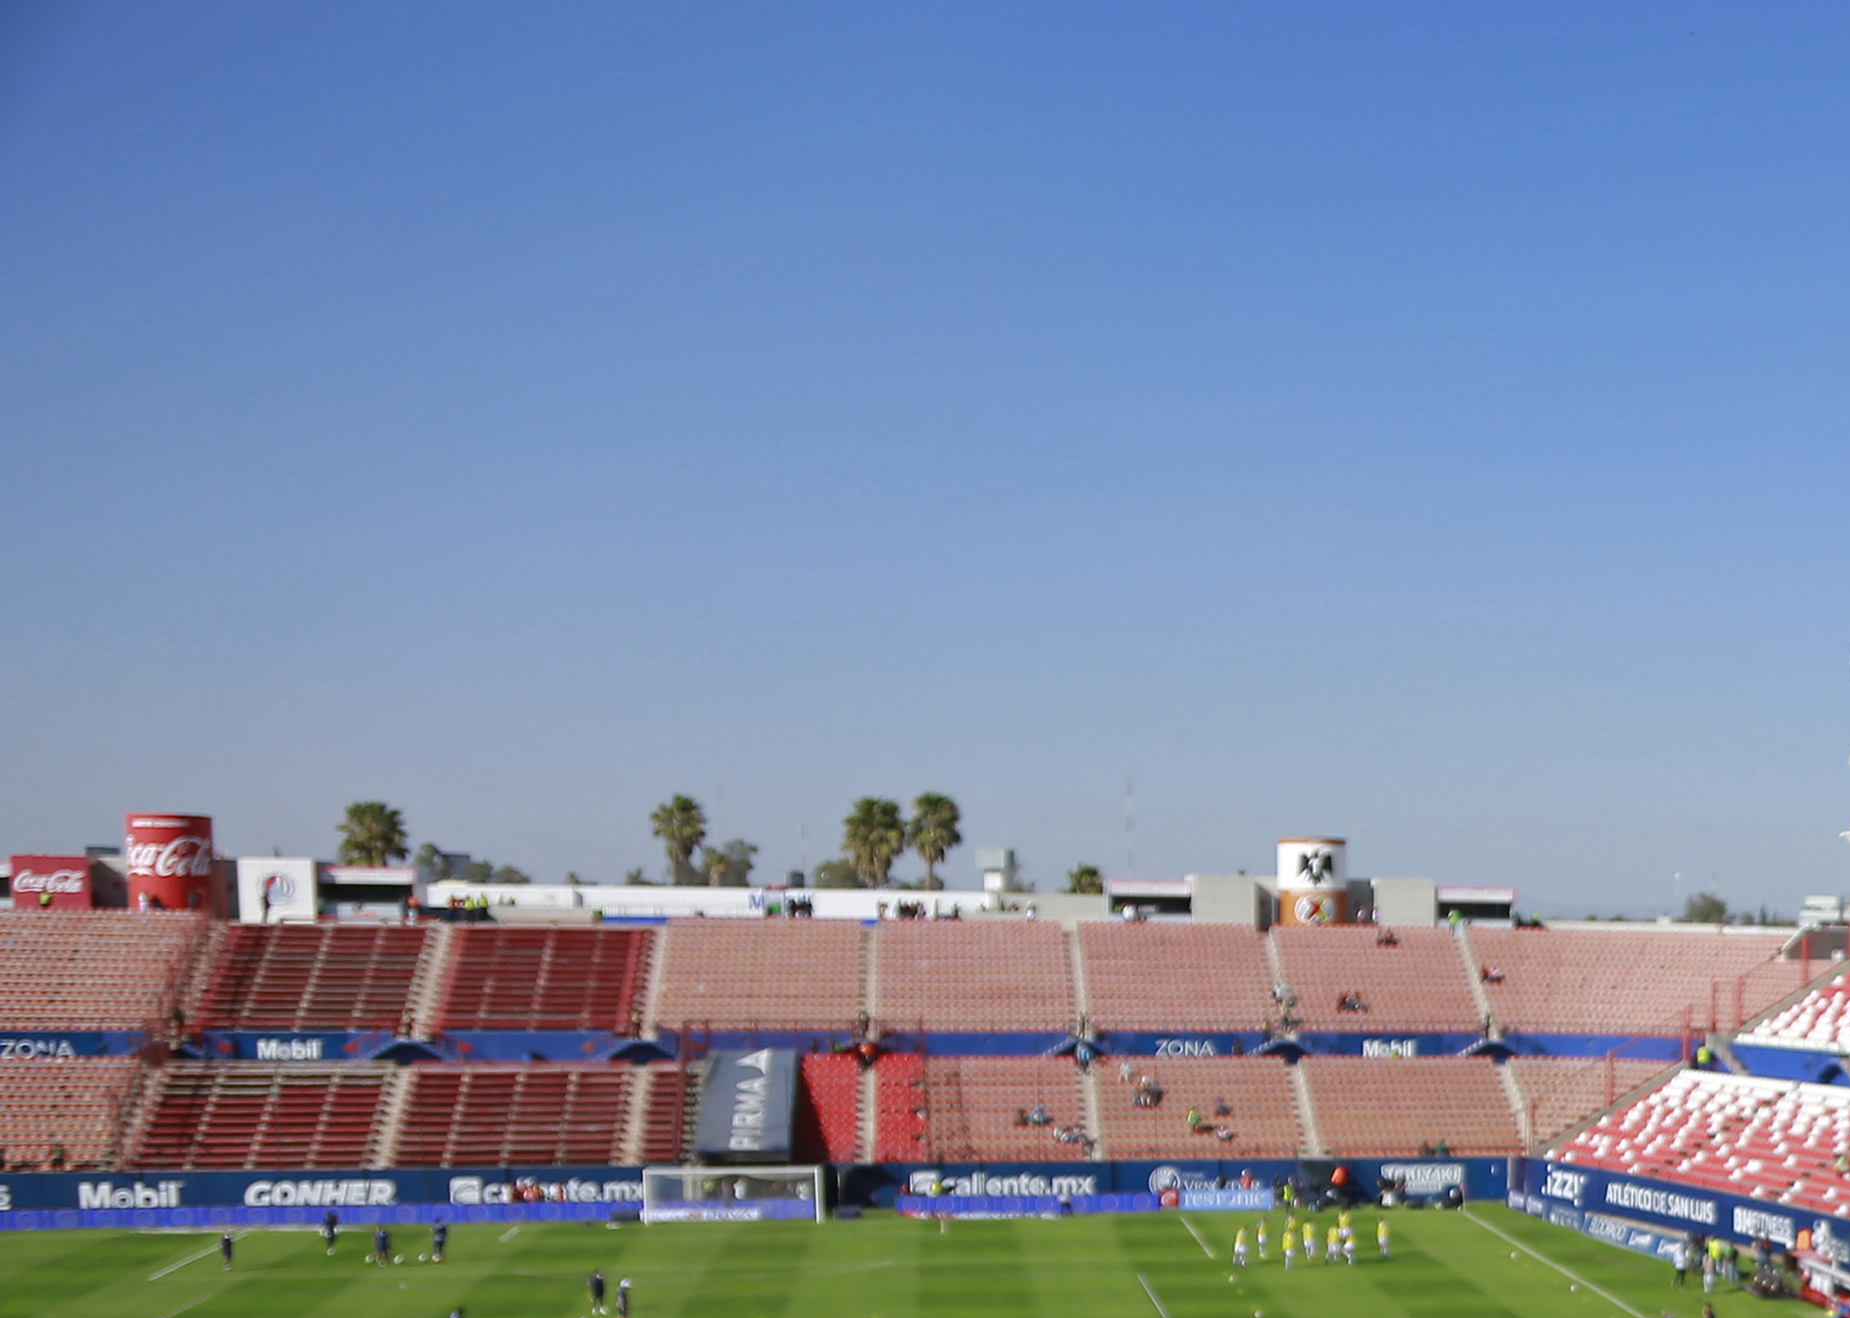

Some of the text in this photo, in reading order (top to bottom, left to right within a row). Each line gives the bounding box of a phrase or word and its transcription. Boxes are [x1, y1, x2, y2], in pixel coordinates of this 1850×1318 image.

[256, 1038, 323, 1060] Mobil
[1155, 1039, 1213, 1057] ZONA
[78, 1181, 184, 1209] Mobil
[244, 1180, 398, 1206] GONHER
[1605, 1181, 1716, 1225] ATLÉTICO DE SAN LUIS
